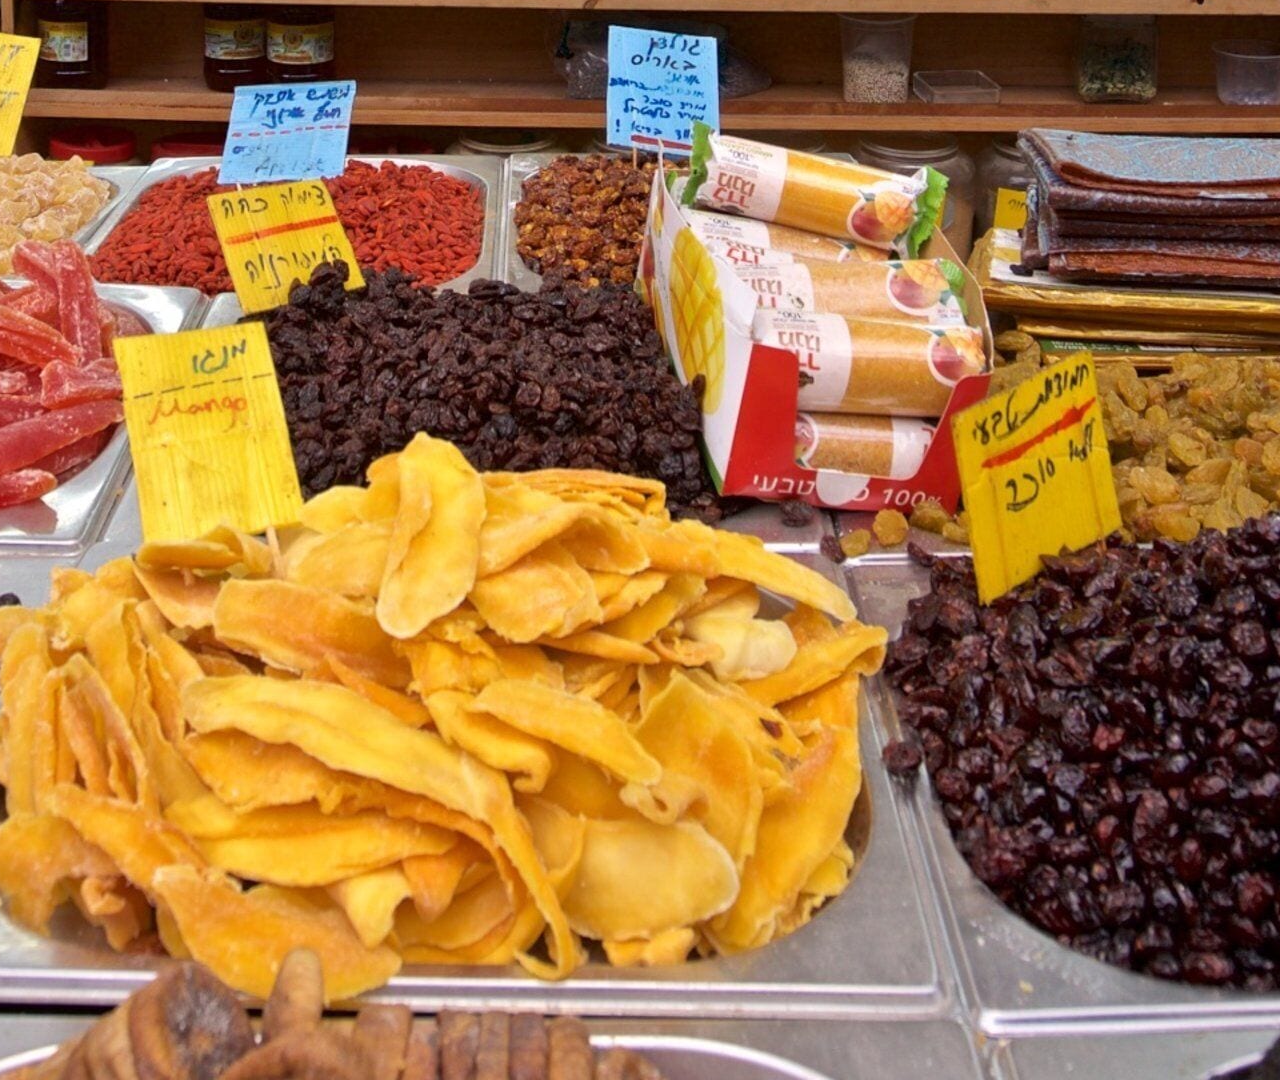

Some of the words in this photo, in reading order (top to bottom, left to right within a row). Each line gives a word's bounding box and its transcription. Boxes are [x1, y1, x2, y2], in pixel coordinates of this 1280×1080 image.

[192, 339, 247, 375] מנגו
[148, 395, 249, 434] Mango
[1005, 456, 1056, 512] סוכר
